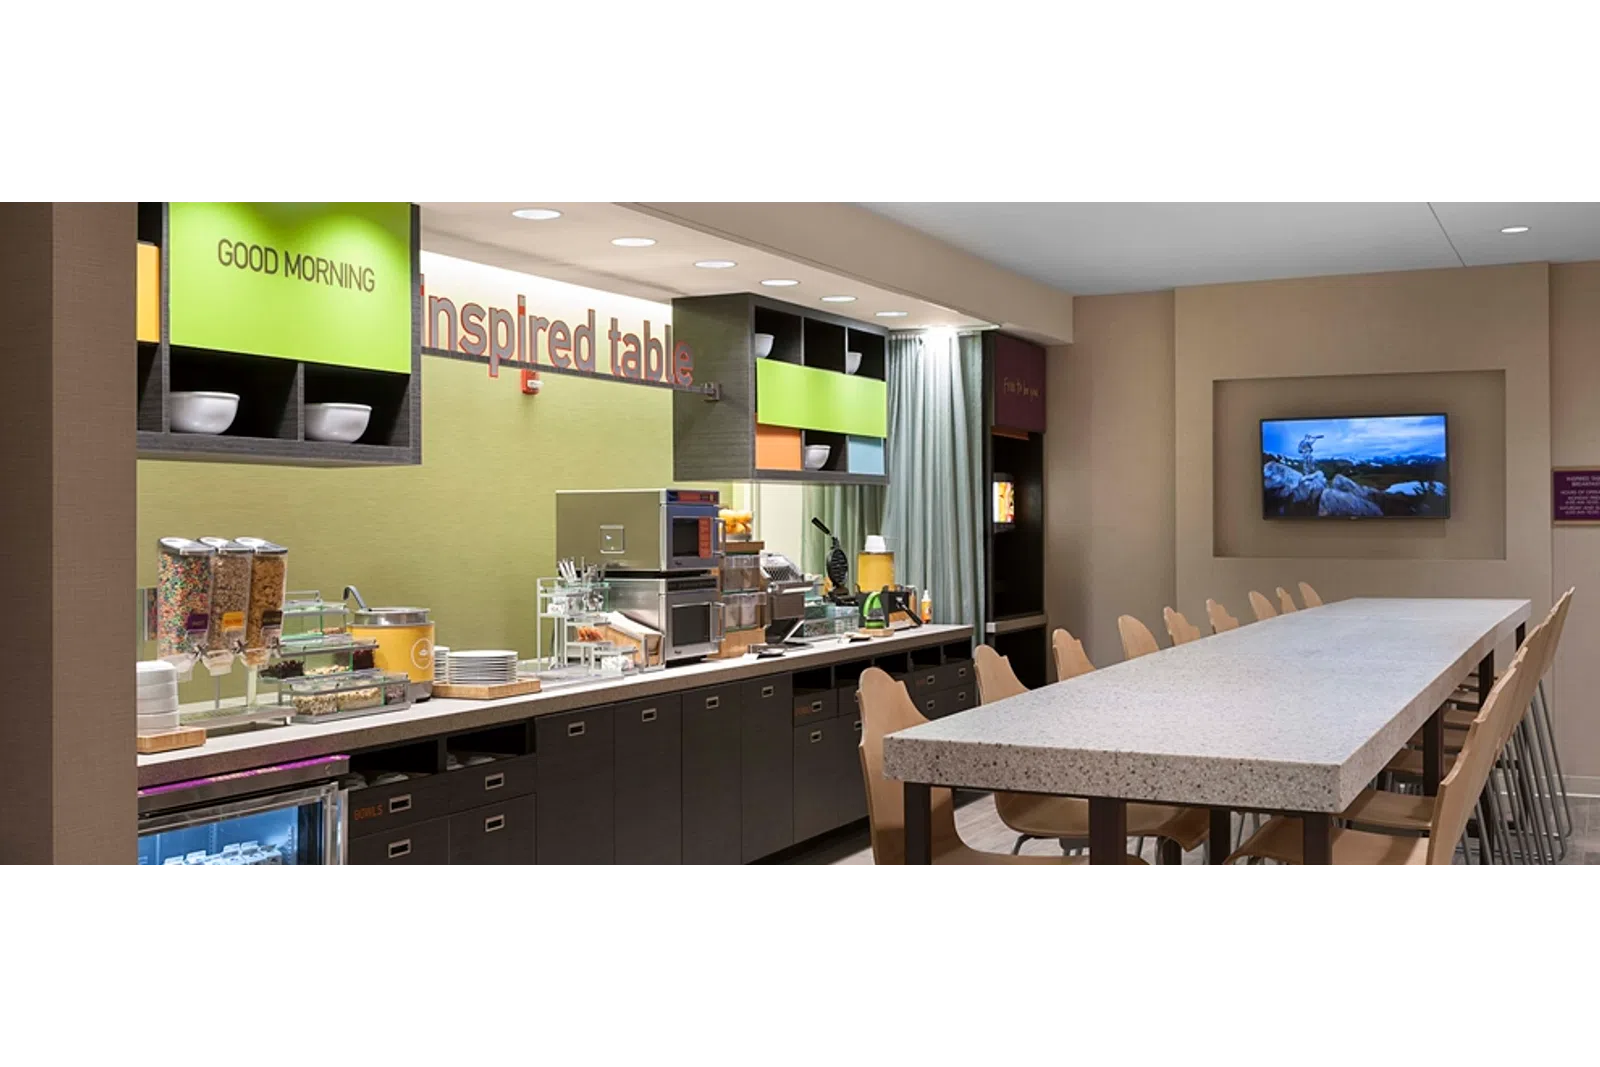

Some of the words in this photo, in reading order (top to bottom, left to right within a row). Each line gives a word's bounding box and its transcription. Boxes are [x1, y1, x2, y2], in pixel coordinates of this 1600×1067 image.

[217, 238, 279, 275] GOOD
[284, 250, 375, 293] MORNING
[608, 316, 694, 387] table
[353, 804, 383, 821] BOWLS
